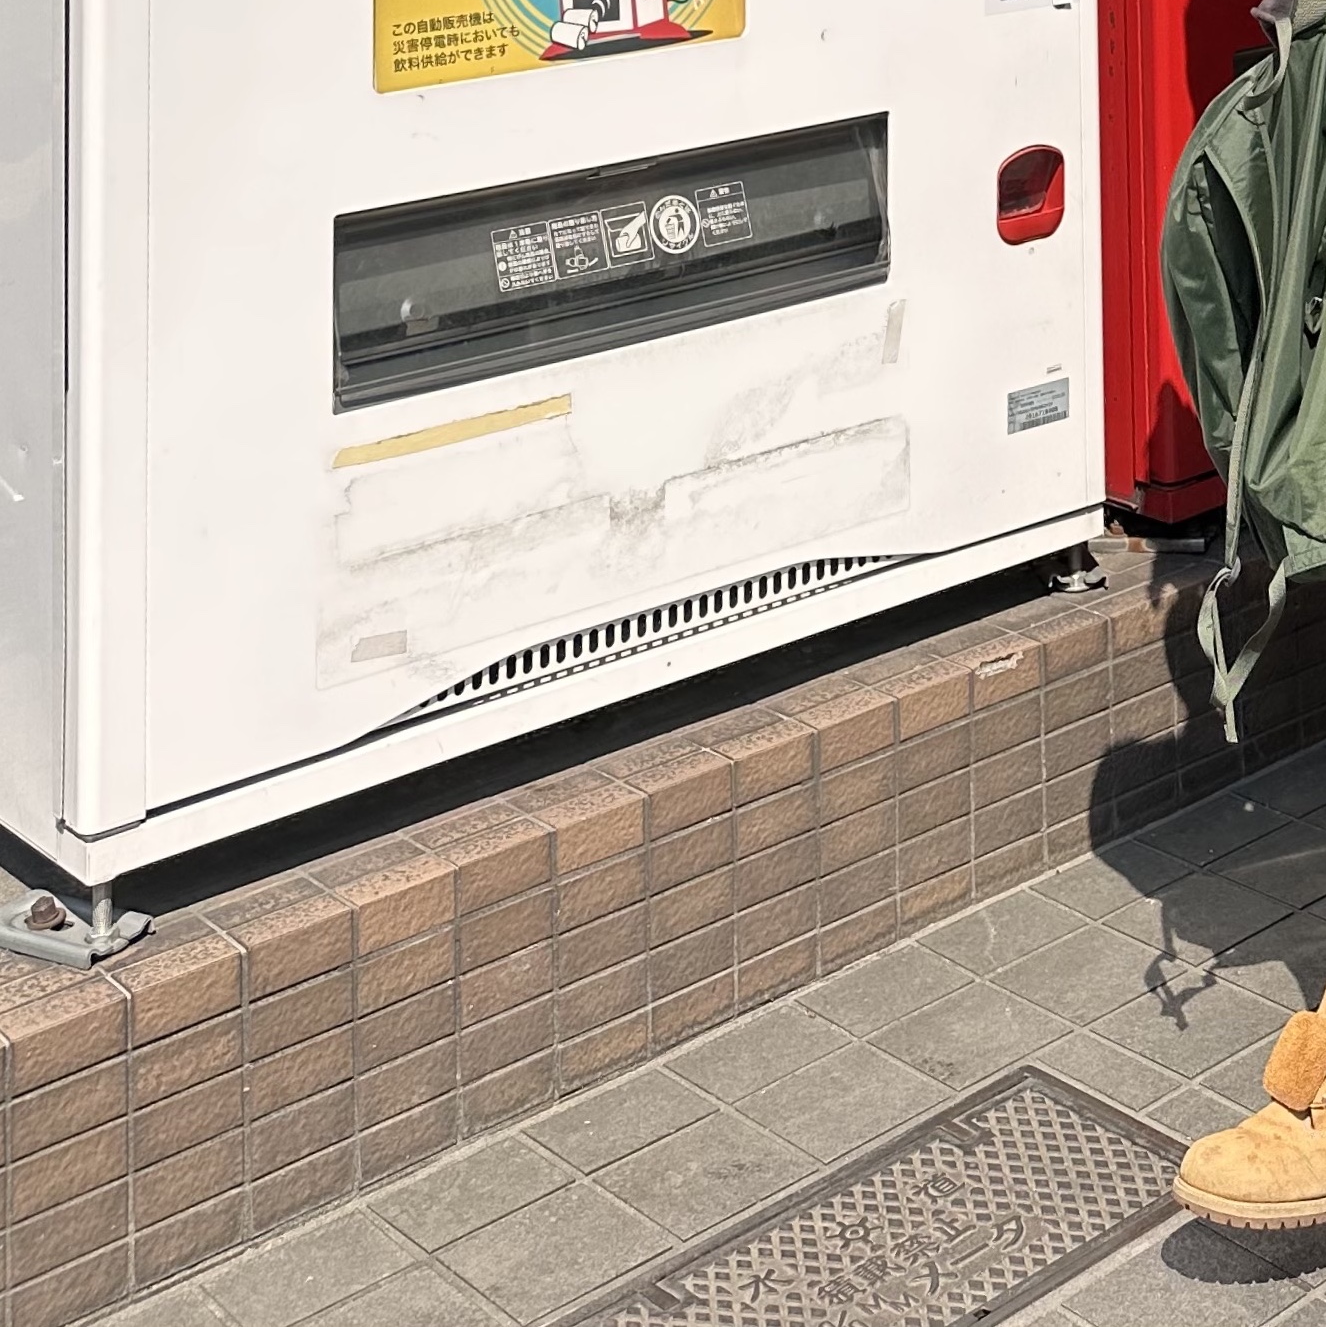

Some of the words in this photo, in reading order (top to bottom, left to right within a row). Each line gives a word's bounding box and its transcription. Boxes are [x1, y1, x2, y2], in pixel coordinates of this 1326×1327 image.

[391, 11, 495, 38] この自動販売機は
[392, 25, 520, 55] 災害停電時においても
[393, 43, 509, 73] 飲料供給ができます
